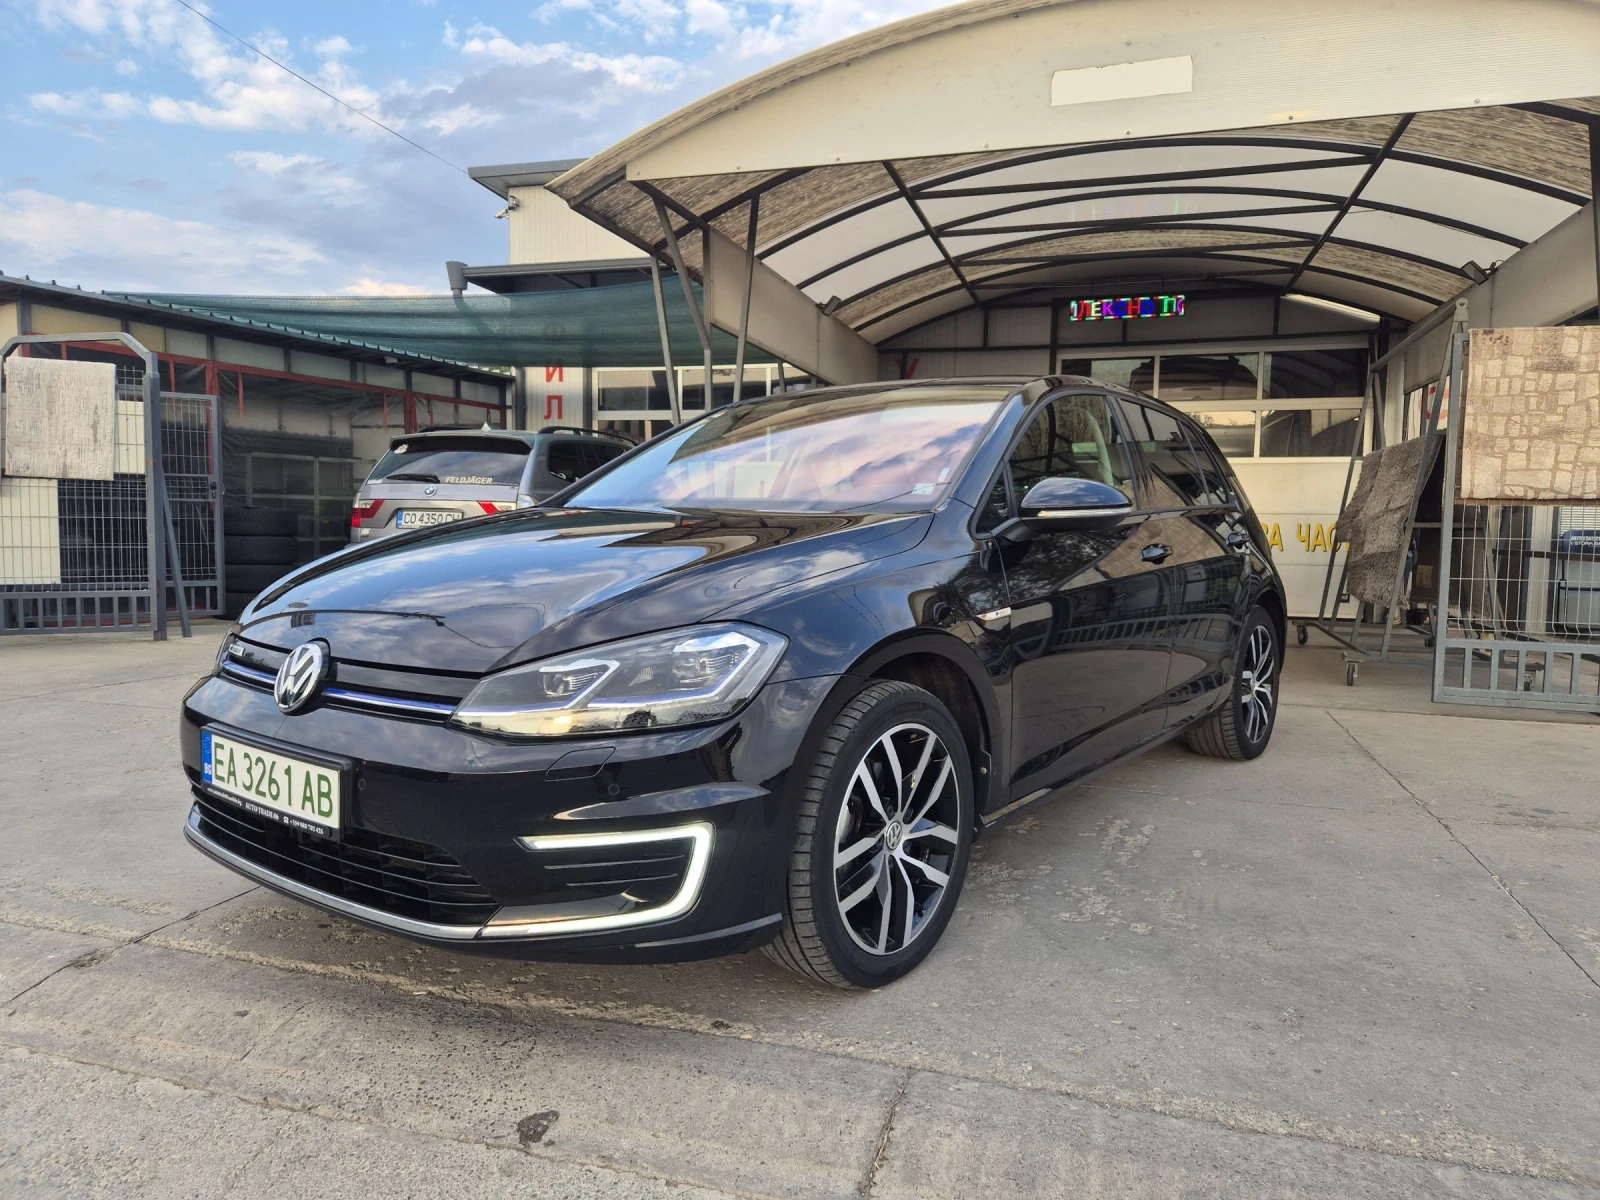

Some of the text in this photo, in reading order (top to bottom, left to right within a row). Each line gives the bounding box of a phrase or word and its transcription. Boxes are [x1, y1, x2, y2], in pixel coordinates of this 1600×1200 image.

[446, 475, 493, 485] FELDJÄGER
[403, 513, 417, 524] CO
[418, 513, 443, 525] 4350
[214, 741, 333, 818] EA 3261 AB
